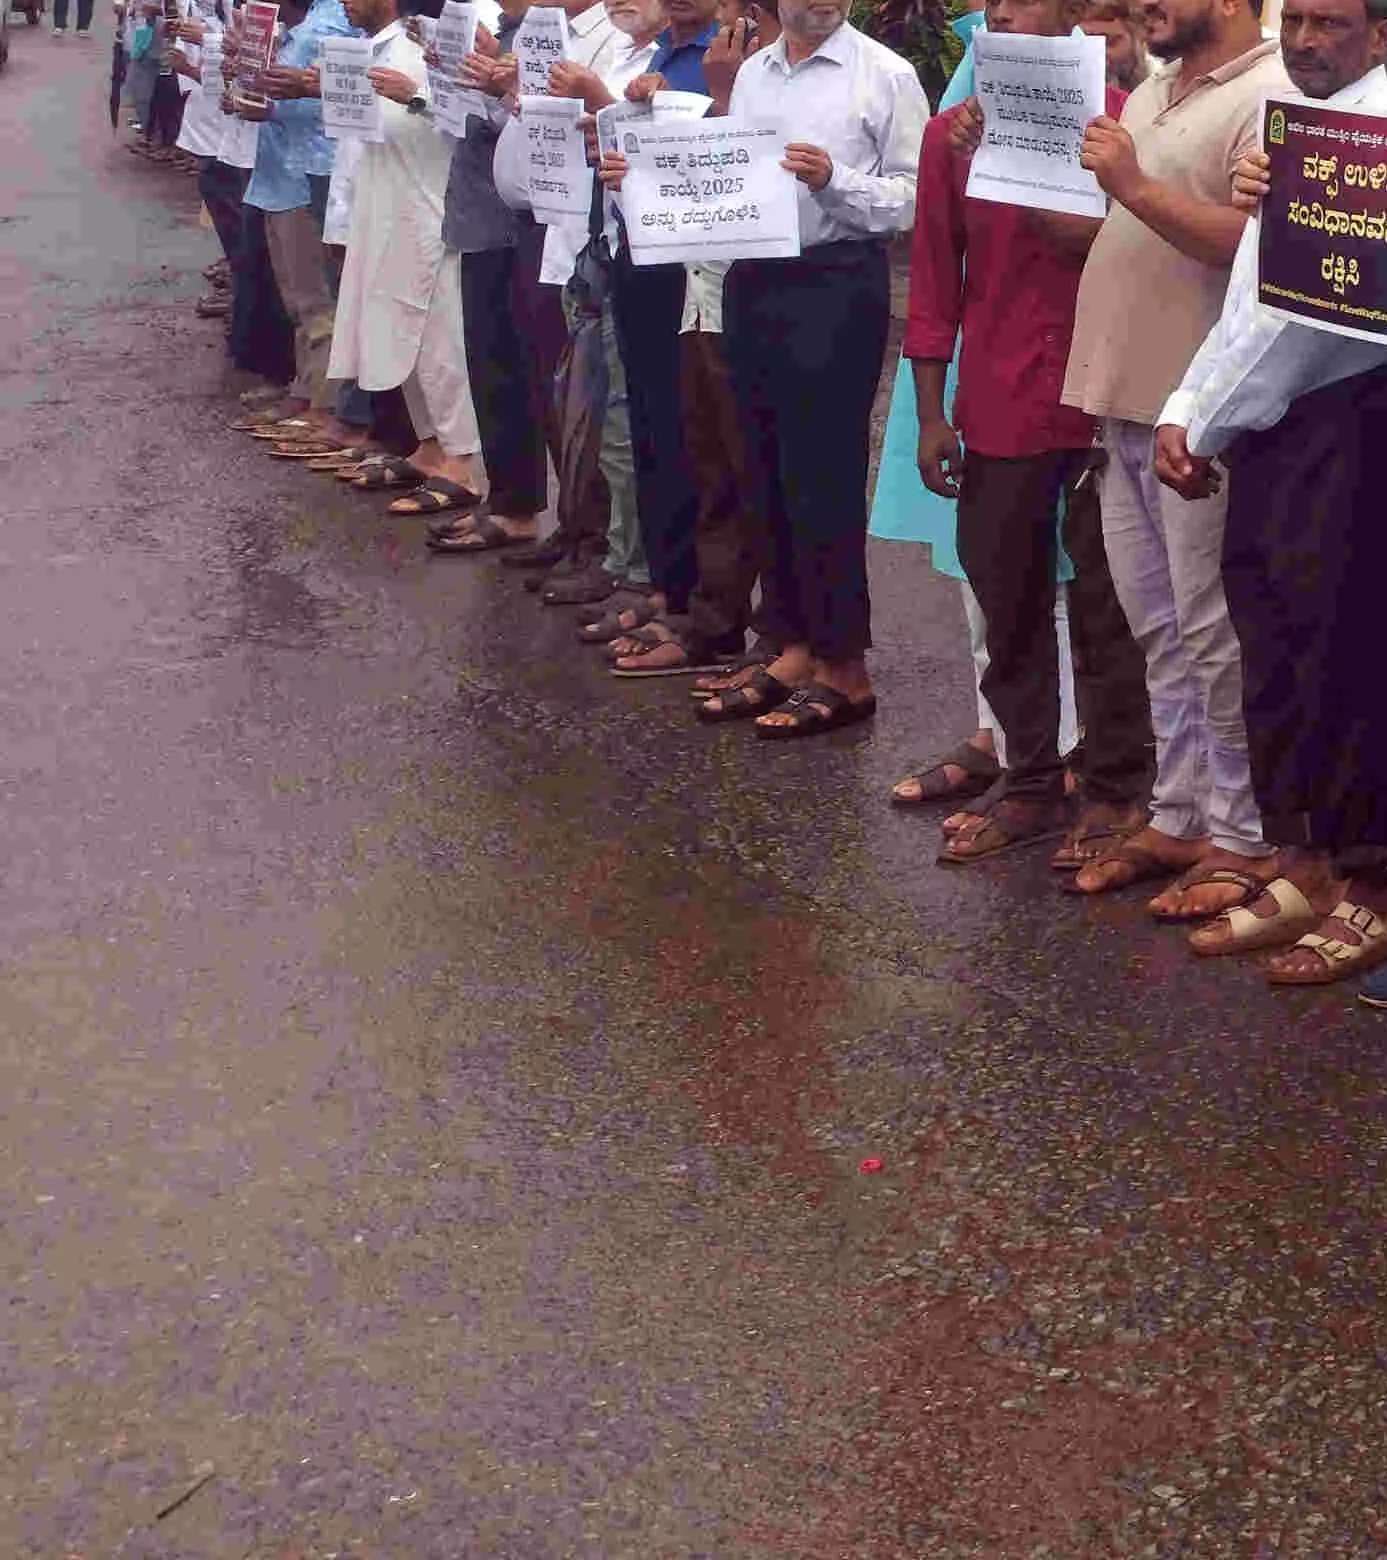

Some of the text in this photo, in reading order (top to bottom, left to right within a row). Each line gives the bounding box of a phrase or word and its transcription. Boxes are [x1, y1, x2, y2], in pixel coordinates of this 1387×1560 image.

[1057, 88, 1084, 105] 2025
[687, 148, 750, 175] ತಿದ್ದುಪಡಿ
[702, 177, 744, 197] 2025
[1320, 250, 1361, 295] ರಕ್ಷಿಸಿ
